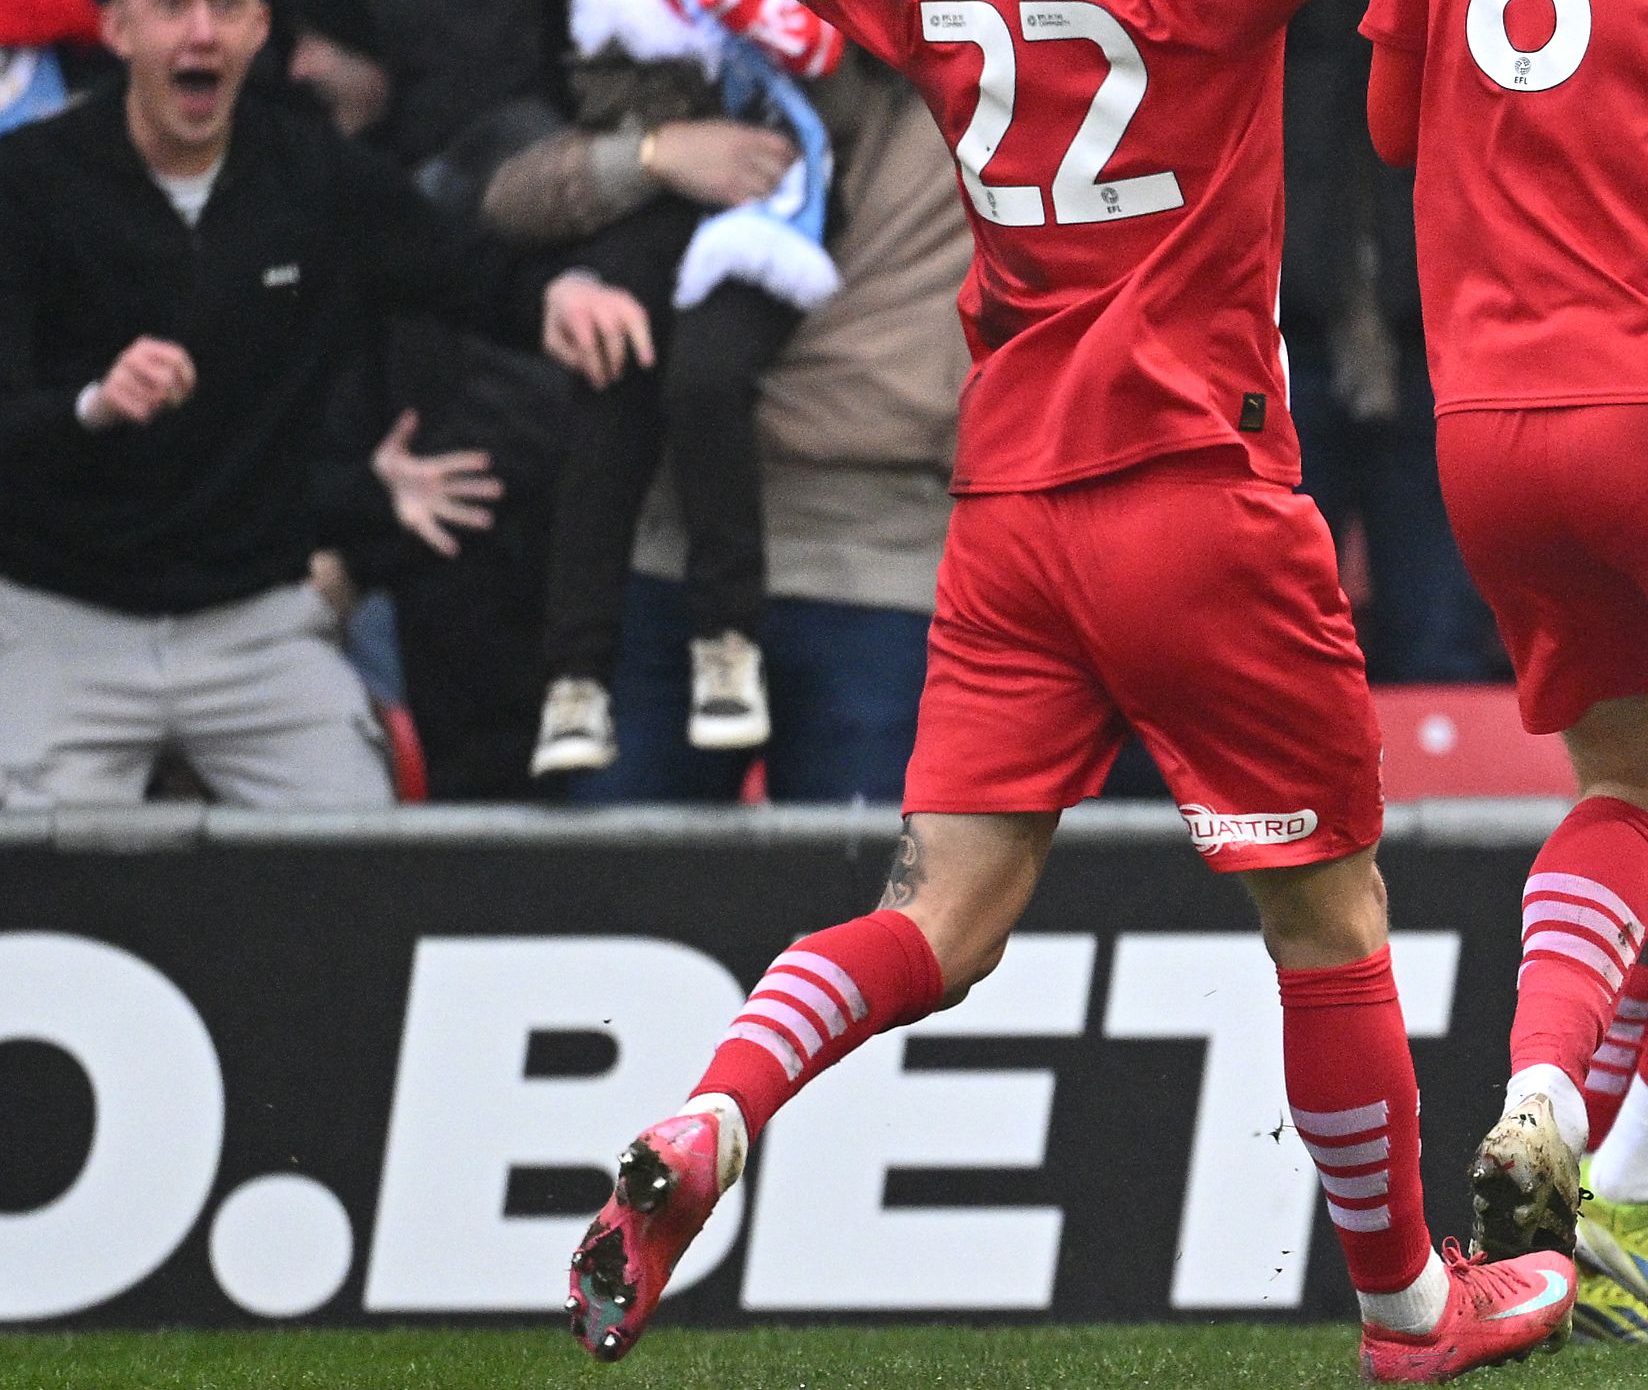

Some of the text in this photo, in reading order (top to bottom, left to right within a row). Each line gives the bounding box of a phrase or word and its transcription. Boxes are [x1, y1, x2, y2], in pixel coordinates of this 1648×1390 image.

[1514, 76, 1528, 85] EFL
[920, 0, 1185, 227] 22
[1107, 205, 1122, 214] EFL
